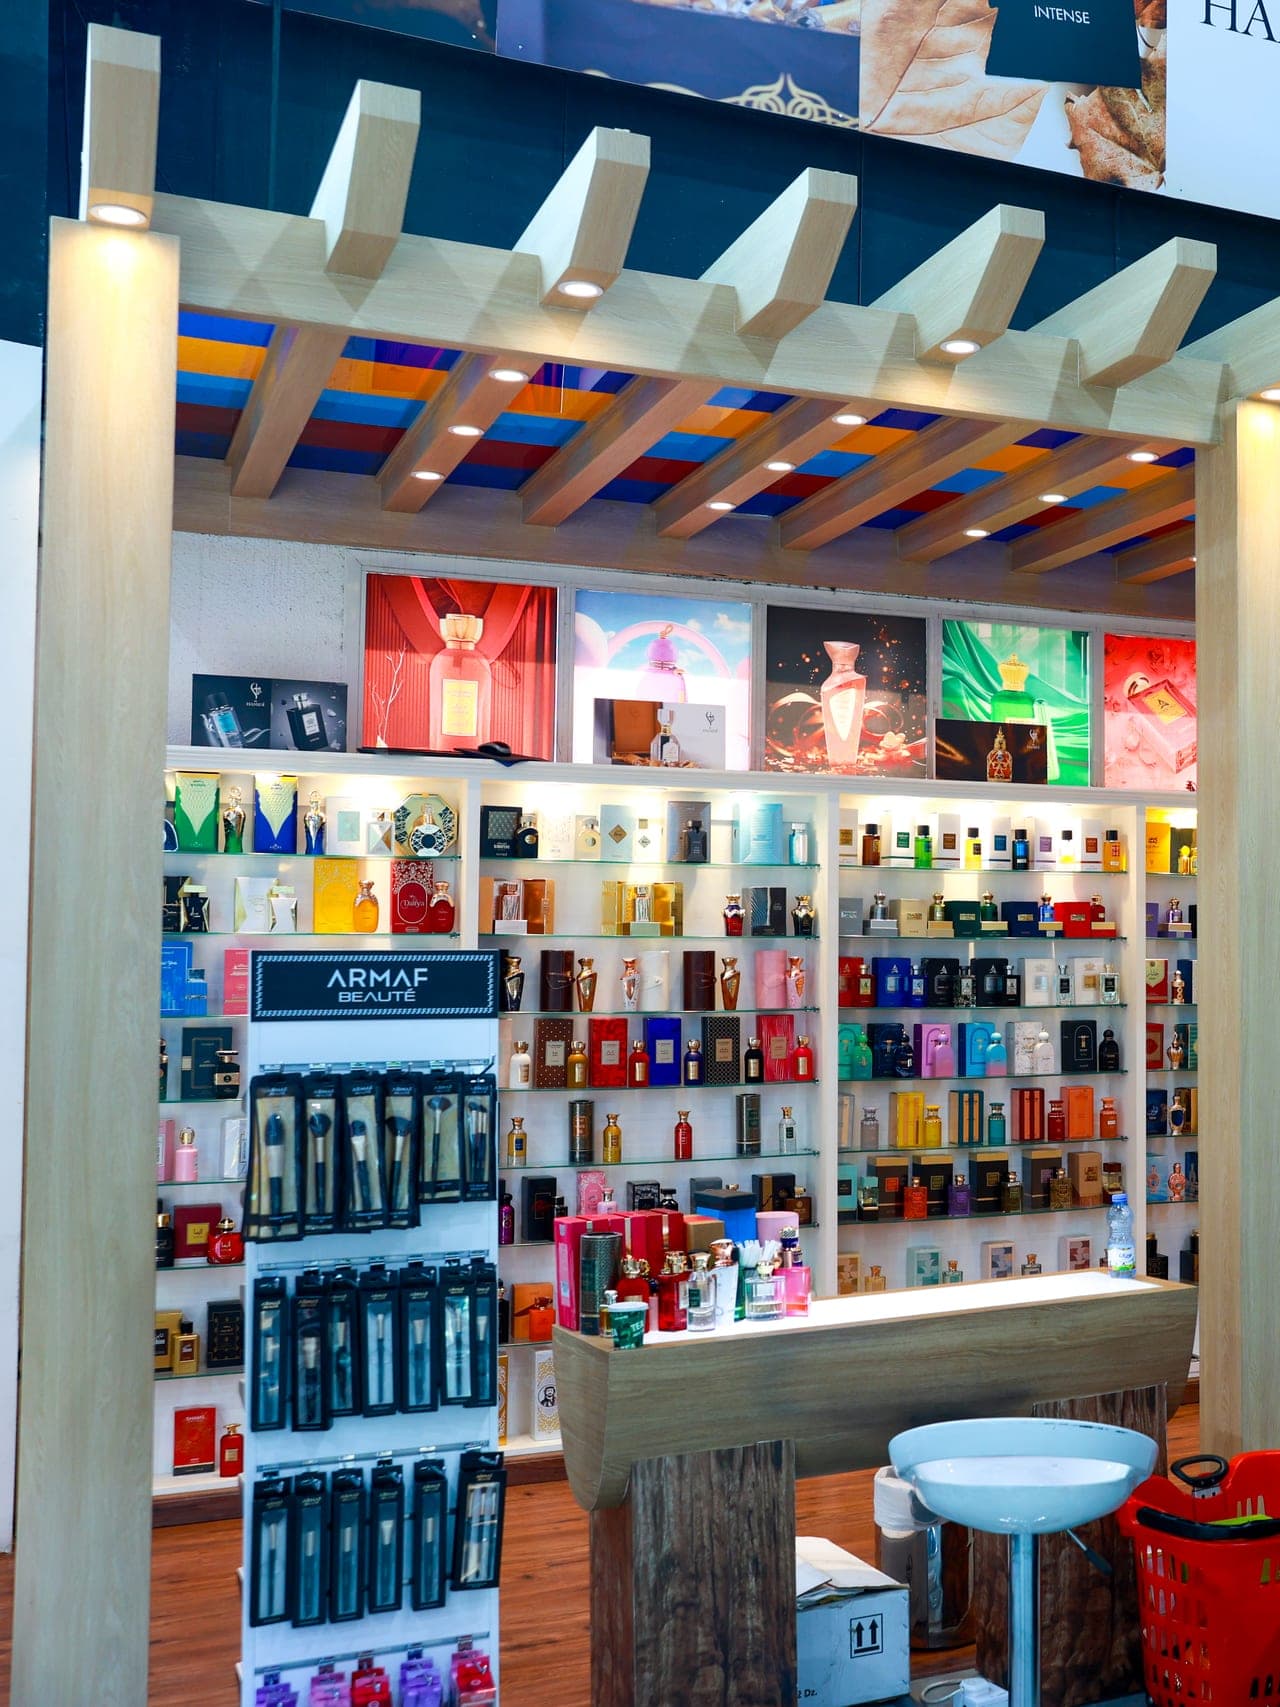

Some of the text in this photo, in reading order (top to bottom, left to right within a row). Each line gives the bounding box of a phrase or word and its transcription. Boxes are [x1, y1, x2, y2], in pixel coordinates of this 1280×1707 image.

[1034, 5, 1091, 24] INTENSE
[327, 967, 429, 988] ARMAF
[338, 988, 416, 1002] BEAUTÉ
